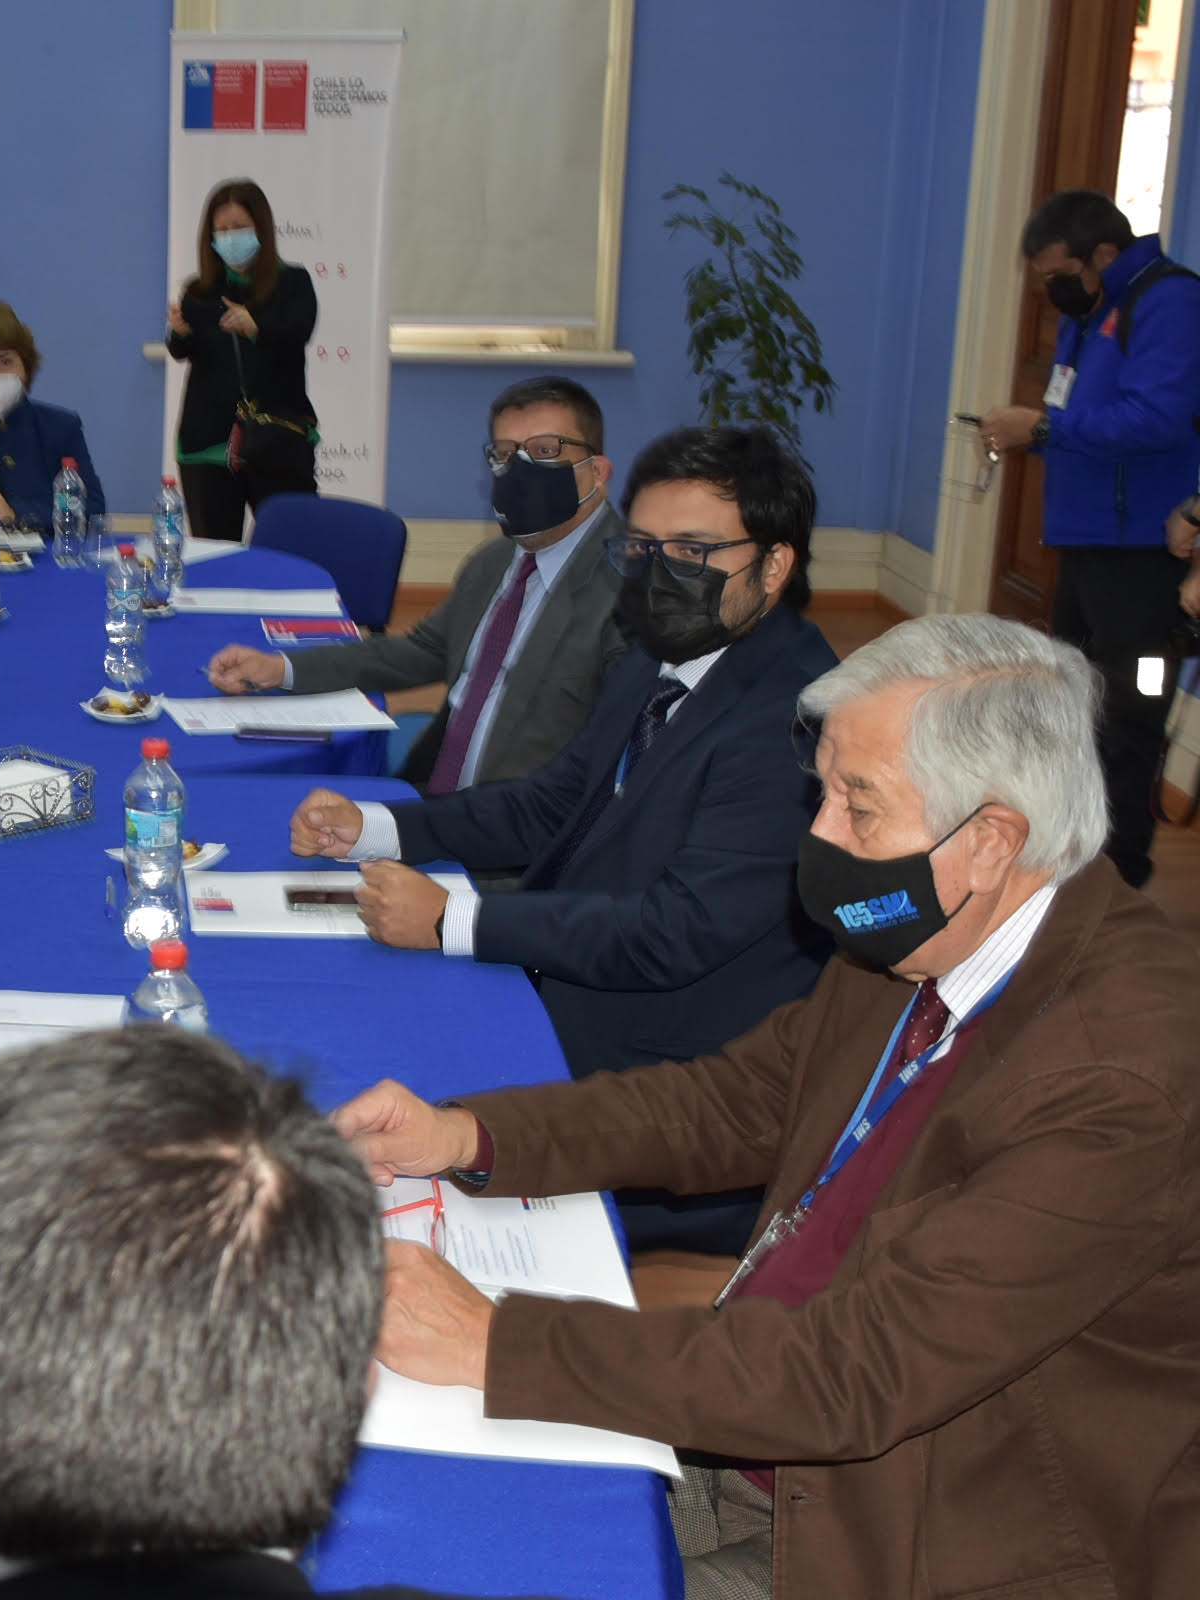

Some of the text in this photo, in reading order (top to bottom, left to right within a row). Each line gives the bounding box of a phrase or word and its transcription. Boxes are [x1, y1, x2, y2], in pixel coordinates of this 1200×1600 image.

[313, 76, 365, 89] CHILE LO
[313, 103, 352, 118] TODOS
[898, 1060, 919, 1084] SML
[852, 1117, 871, 1141] SML
